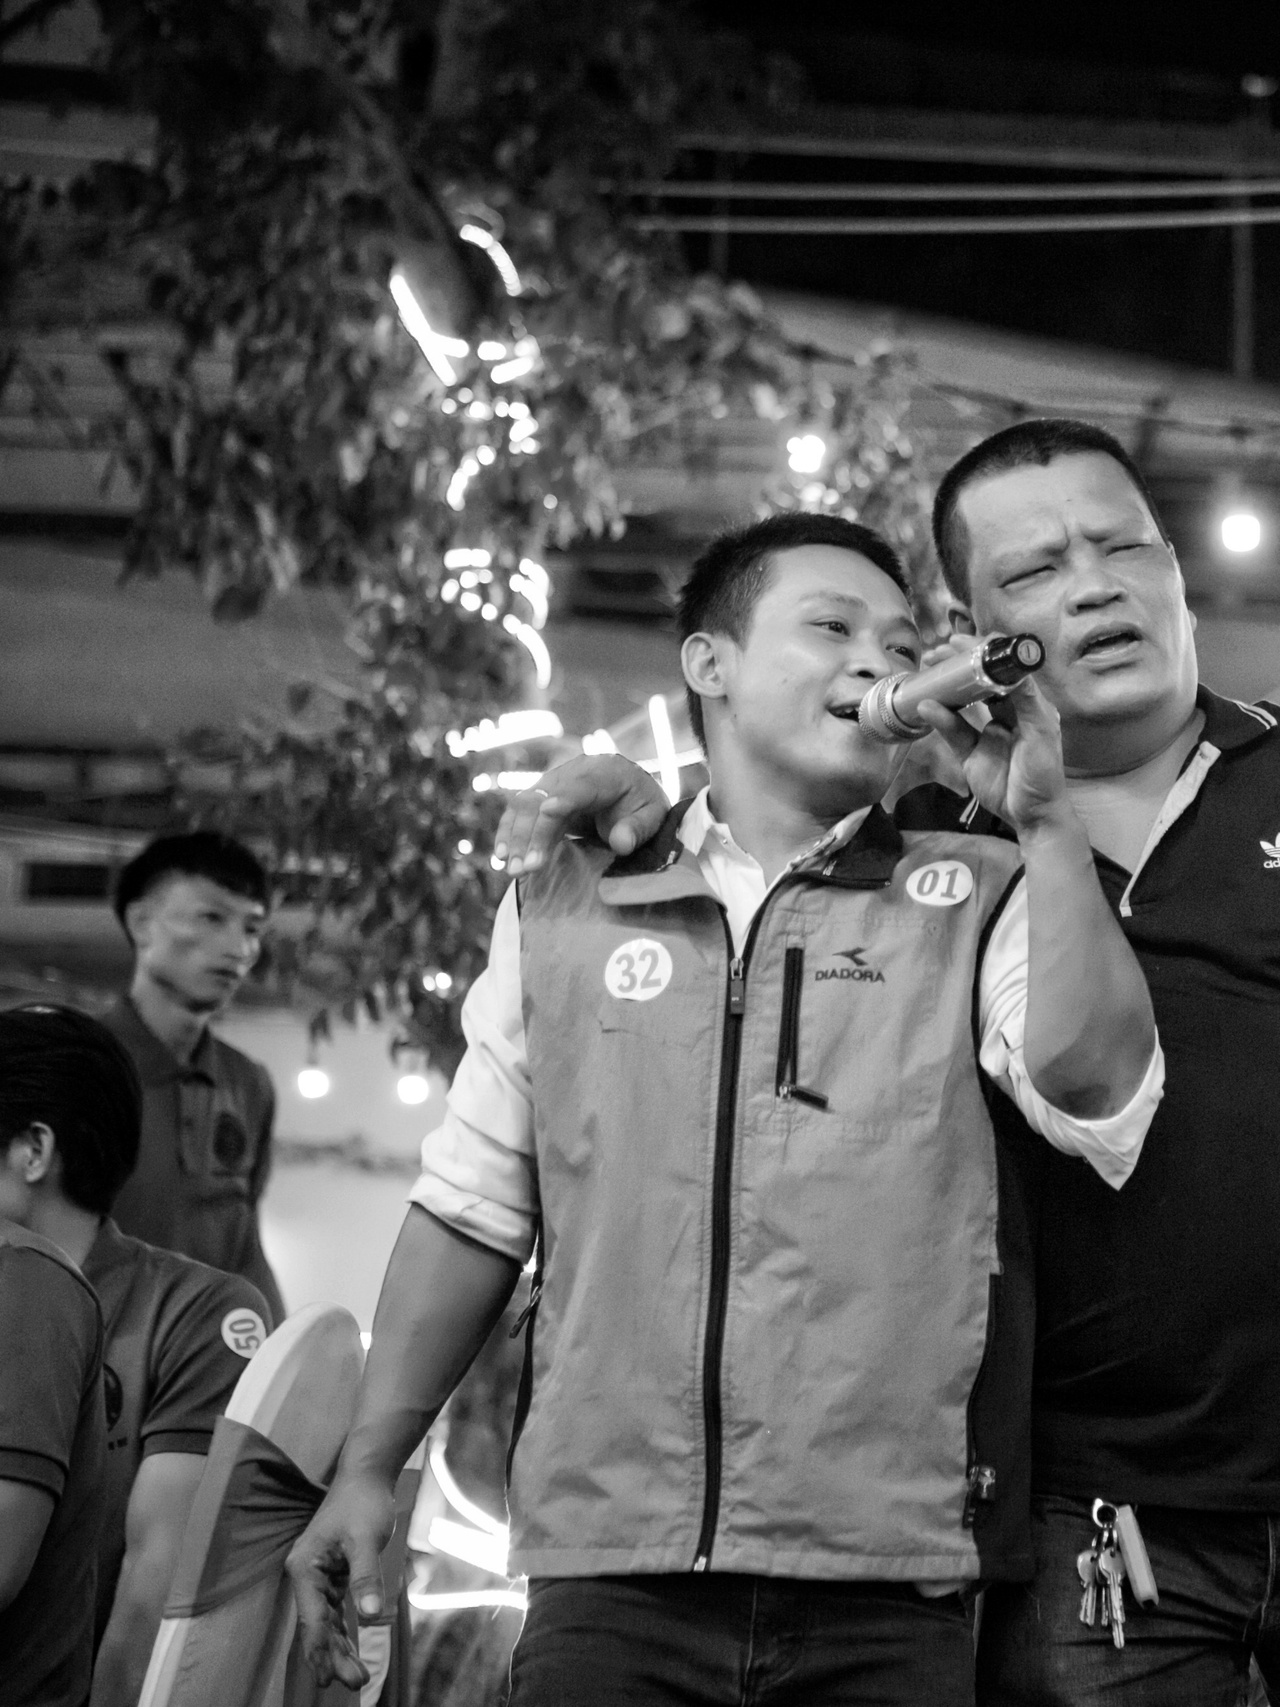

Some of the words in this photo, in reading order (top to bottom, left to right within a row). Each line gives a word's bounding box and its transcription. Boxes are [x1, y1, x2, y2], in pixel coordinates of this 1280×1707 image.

[916, 868, 959, 900] 01
[615, 948, 662, 993] 32
[815, 968, 886, 983] DIADORA
[229, 1318, 260, 1351] 50
